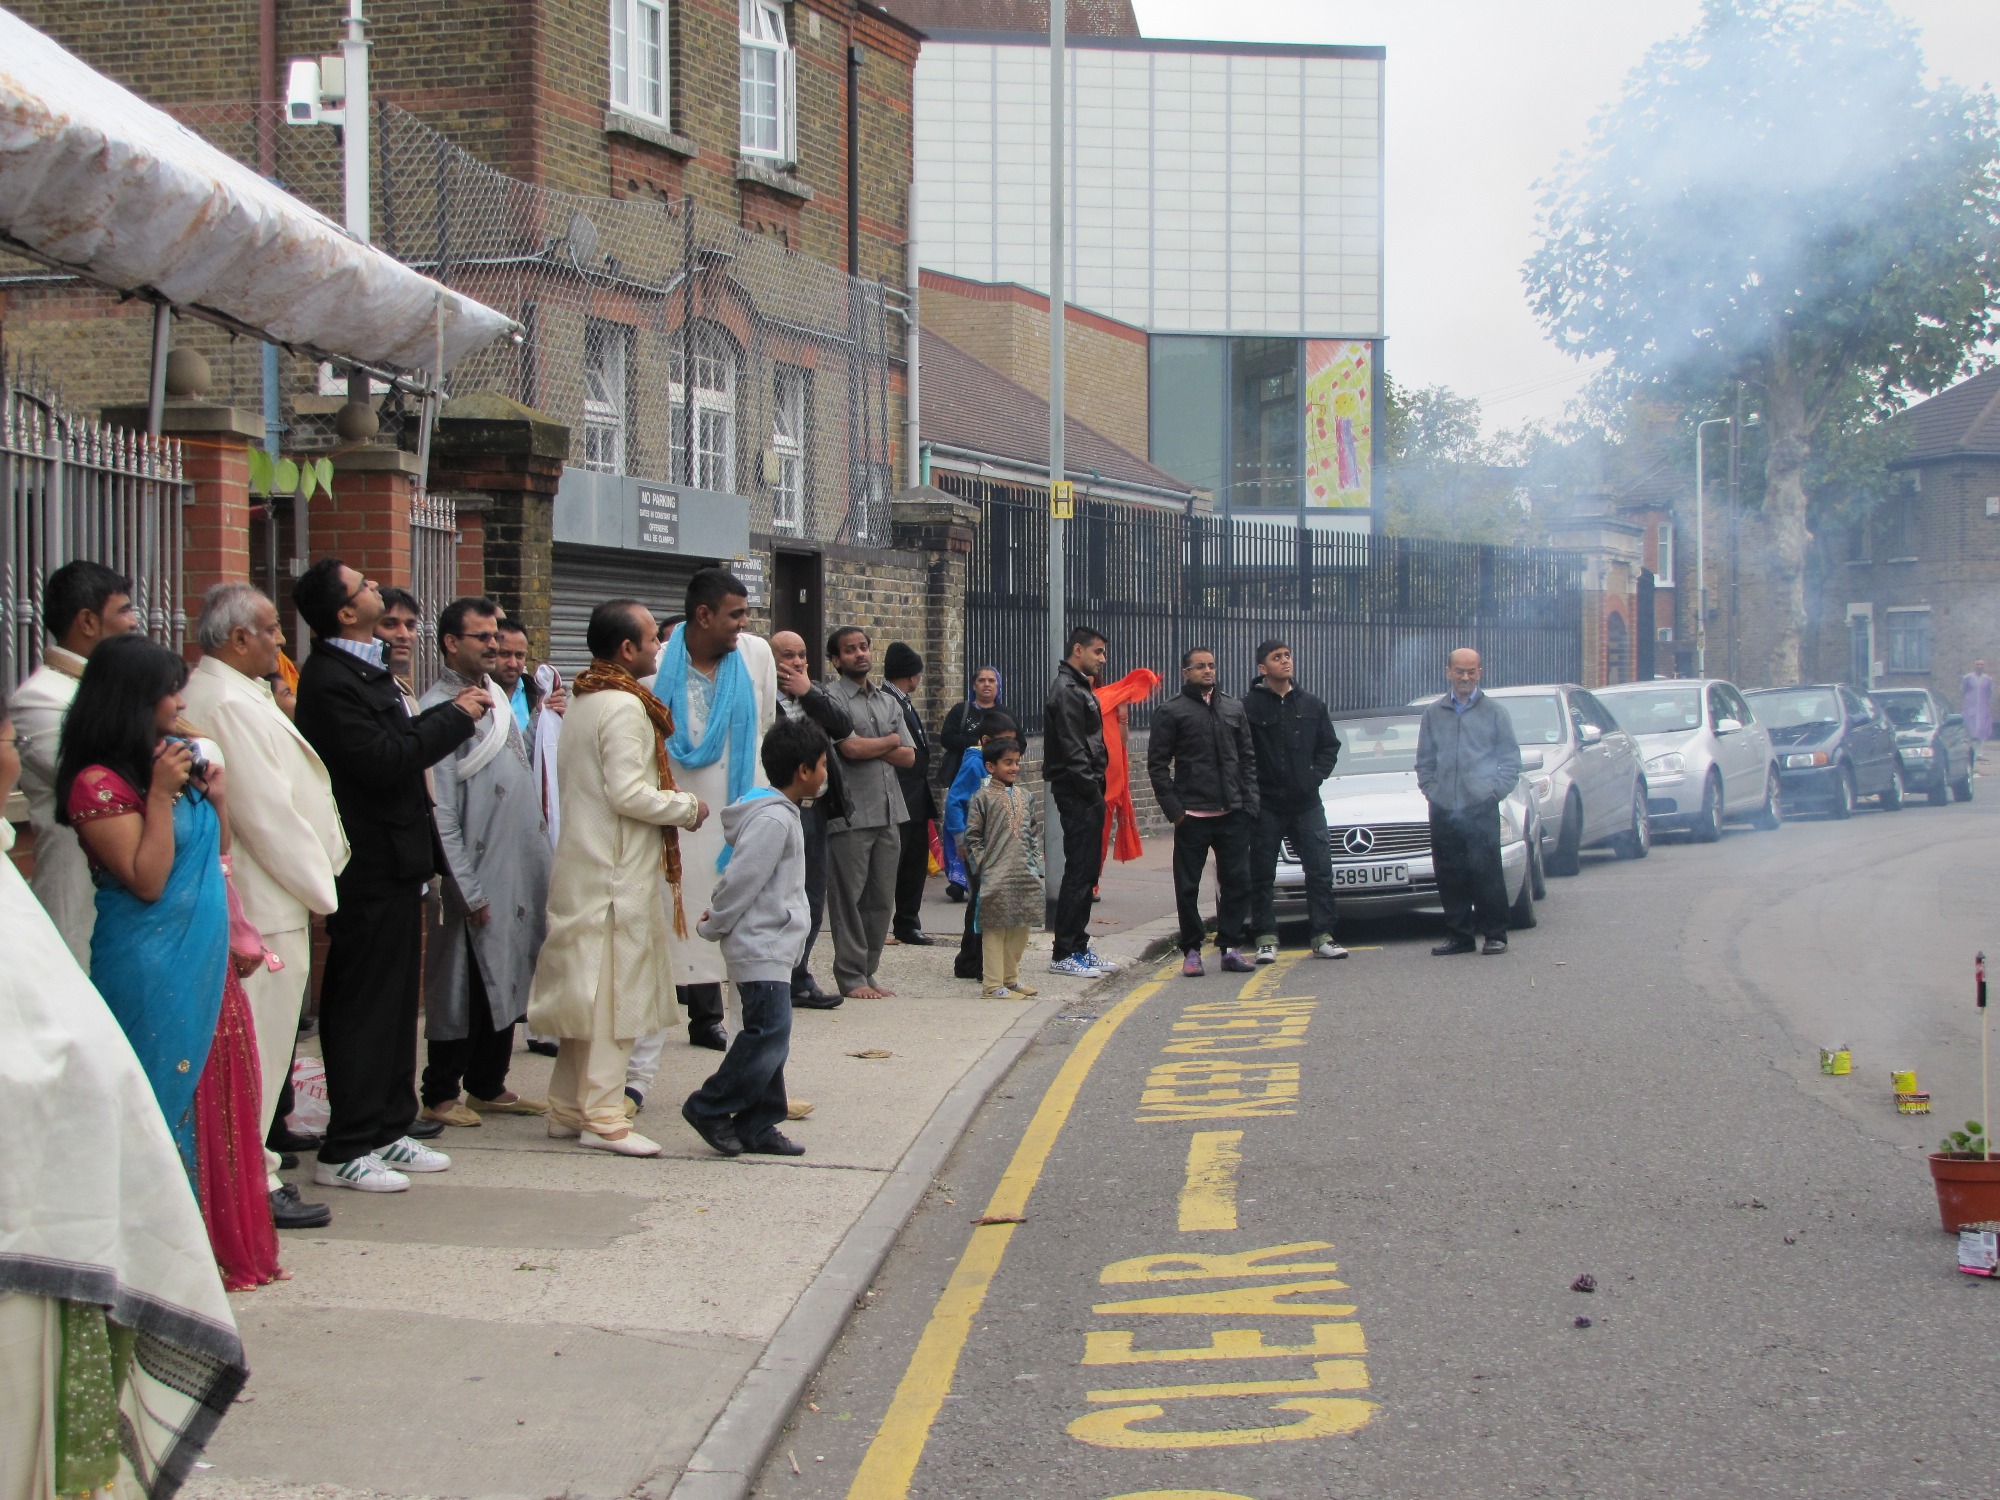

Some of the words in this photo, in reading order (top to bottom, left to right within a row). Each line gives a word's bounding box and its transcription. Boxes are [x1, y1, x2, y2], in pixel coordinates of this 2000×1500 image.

[641, 491, 651, 505] NO
[652, 493, 676, 509] PARKING
[639, 508, 650, 518] GATES
[650, 510, 655, 518] IN
[655, 511, 671, 521] CONSTANT
[649, 523, 669, 534] OFFENDERS
[643, 533, 652, 542] WILL
[652, 534, 658, 543] BE
[658, 535, 675, 545] CLAMPED
[1332, 869, 1368, 886] 589
[1372, 866, 1405, 882] UFC
[1160, 995, 1322, 1055] CLEAR
[1133, 1060, 1301, 1123] KEEP
[1066, 1240, 1382, 1449] CLEAR
